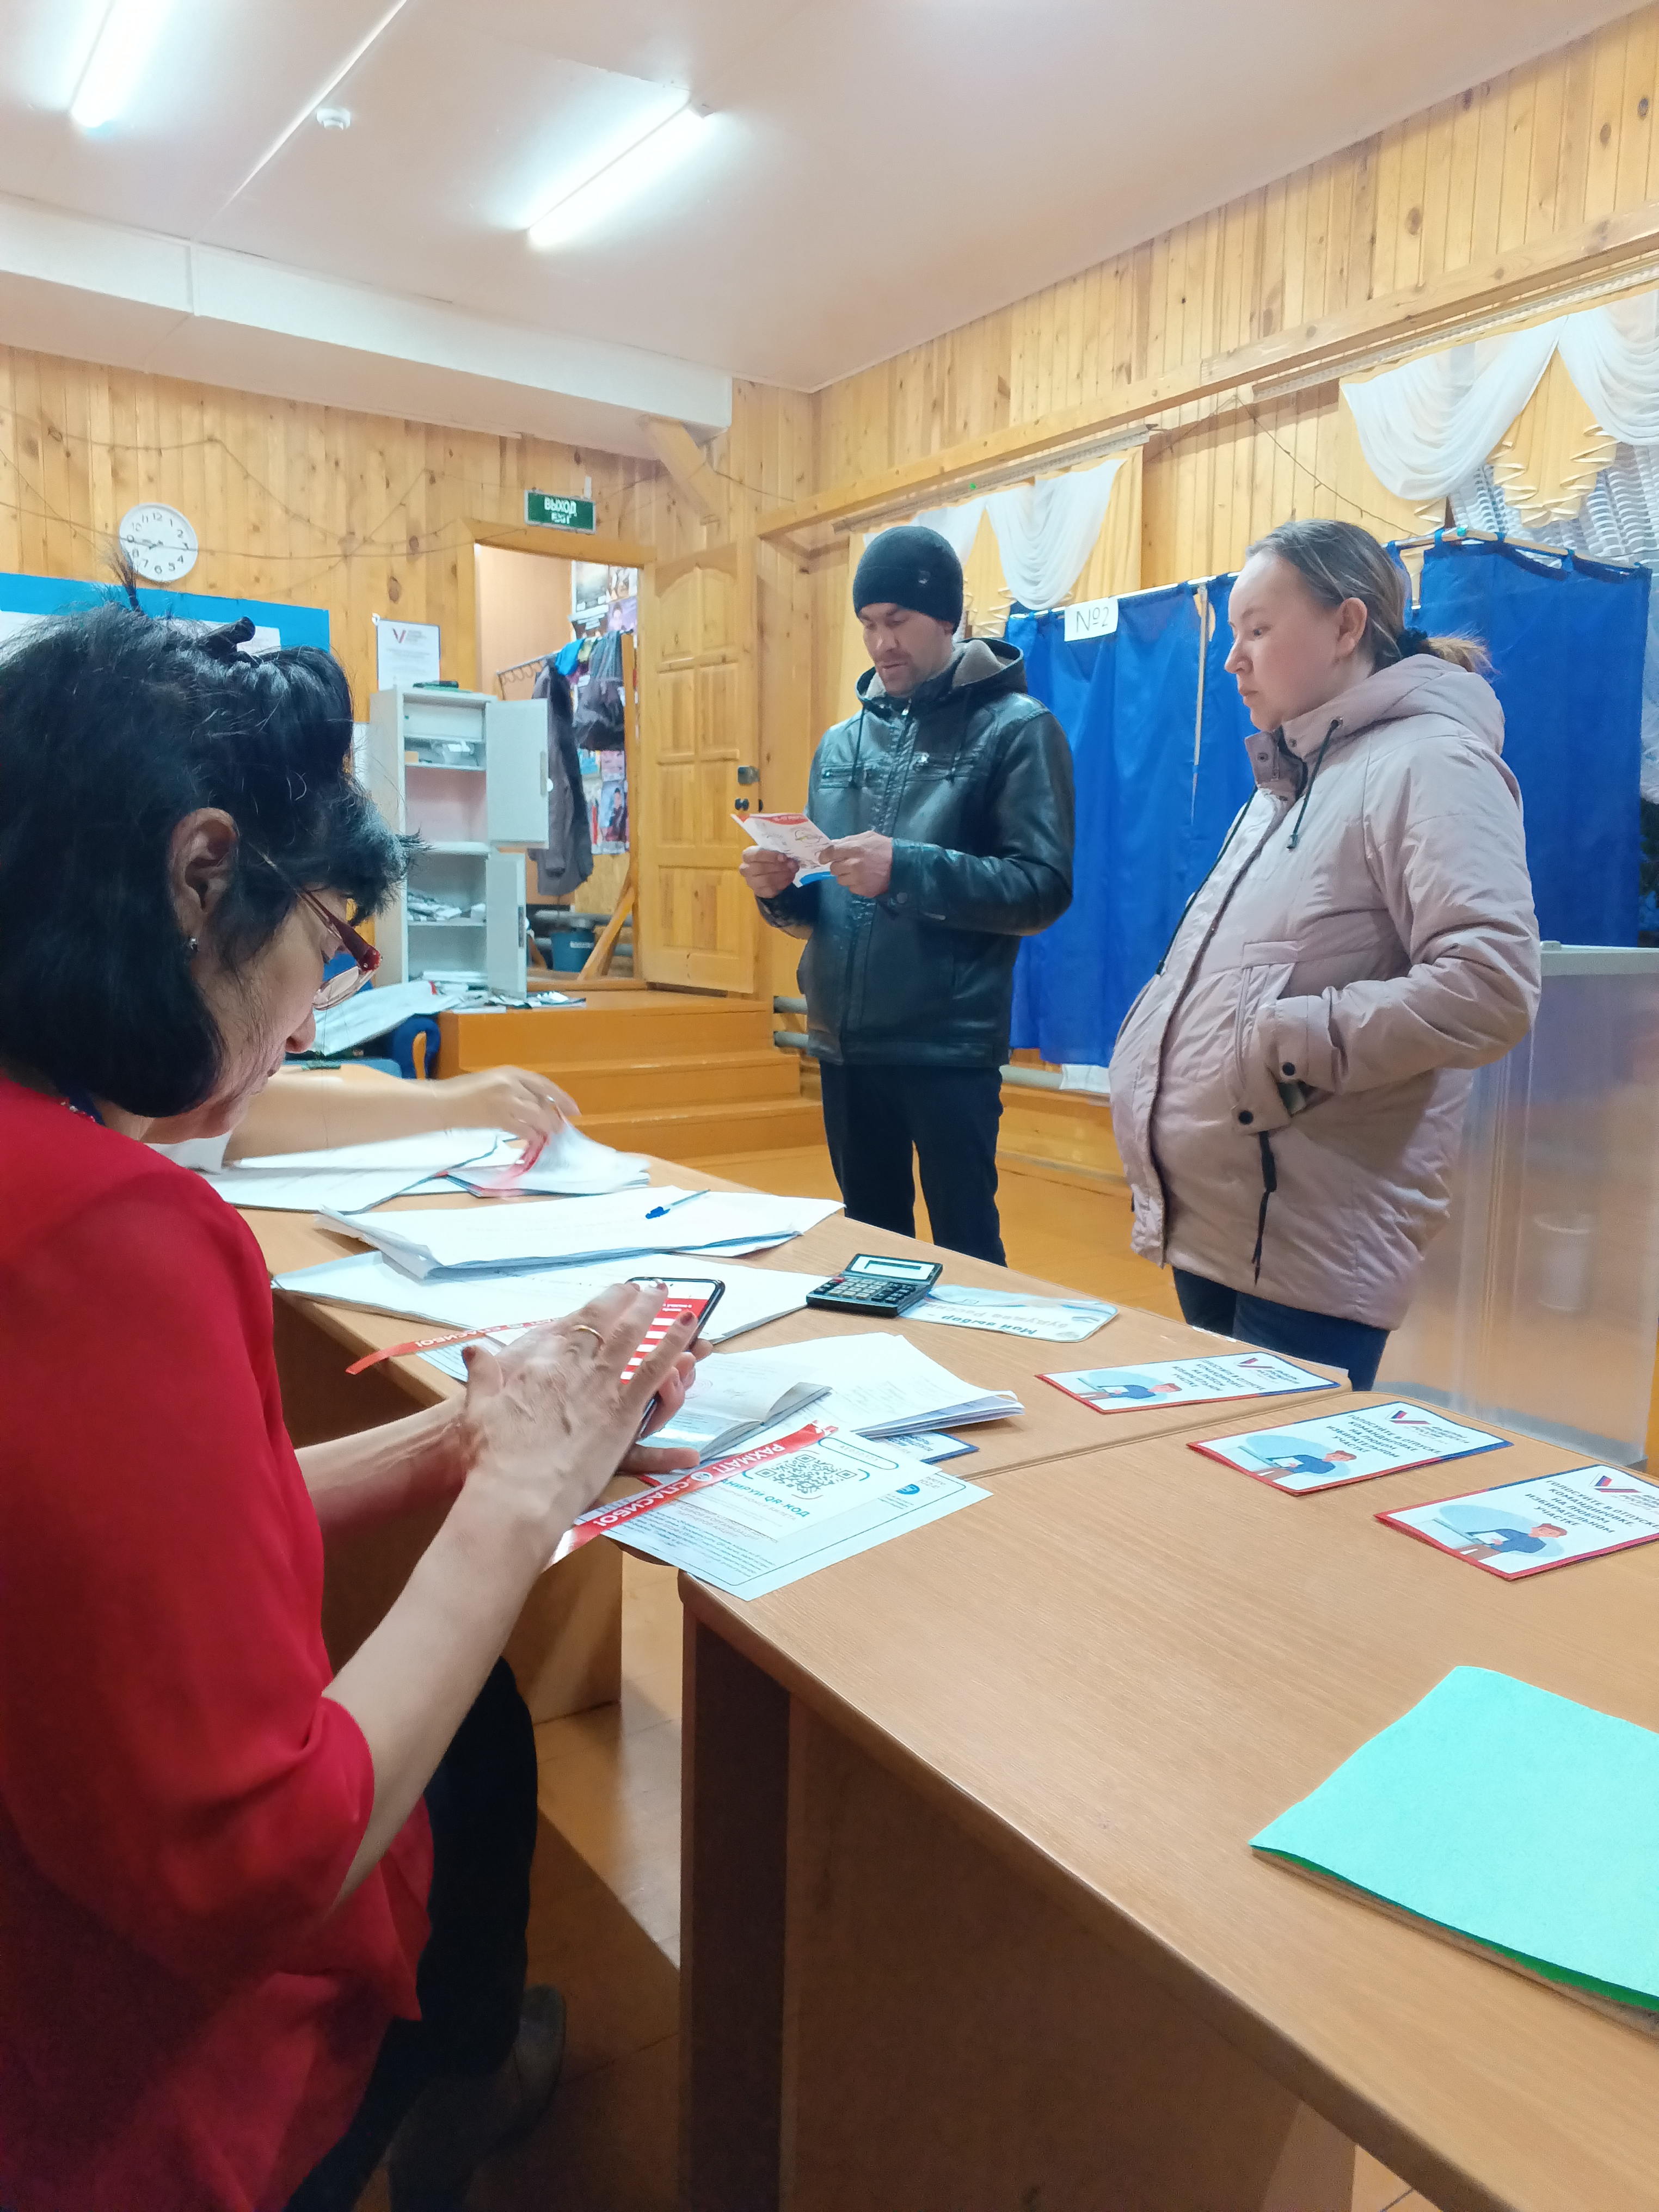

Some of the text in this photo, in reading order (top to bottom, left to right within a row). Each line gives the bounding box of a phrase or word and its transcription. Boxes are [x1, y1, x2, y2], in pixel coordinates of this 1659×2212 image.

[544, 496, 577, 517] ВЫХОД
[142, 514, 149, 523] 11
[152, 512, 162, 521] 12
[170, 518, 173, 527] 1
[551, 512, 572, 524] EXIT
[132, 522, 142, 532] 10
[177, 529, 183, 538] 2
[142, 558, 149, 568] 7
[177, 555, 183, 564] 4
[154, 565, 162, 574] 6
[168, 562, 175, 571] 5
[941, 1316, 996, 1327] выбор
[999, 1324, 1037, 1335] Мой
[1347, 1415, 1396, 1436] ГОЛОСУЙТЕ
[1326, 1425, 1400, 1458] ИЗБИРАТЕЛЬНОМ
[1332, 1436, 1371, 1453] УЧАСТКЕ
[1361, 1435, 1398, 1450] ЛЮБОМ
[712, 1442, 785, 1474] РАХМАТ!
[720, 1478, 765, 1496] АНИРУЙ
[764, 1495, 811, 1517] QR-КОД
[1545, 1480, 1605, 1506] ГОЛОСУЙТЕ
[593, 1480, 689, 1528] СПАСИБО!
[1525, 1494, 1615, 1533] ИЗБИРАТЕЛЬНОМ
[1534, 1506, 1582, 1526] УЧАСТКЕ
[1566, 1505, 1610, 1523] ЛЮБОМ
